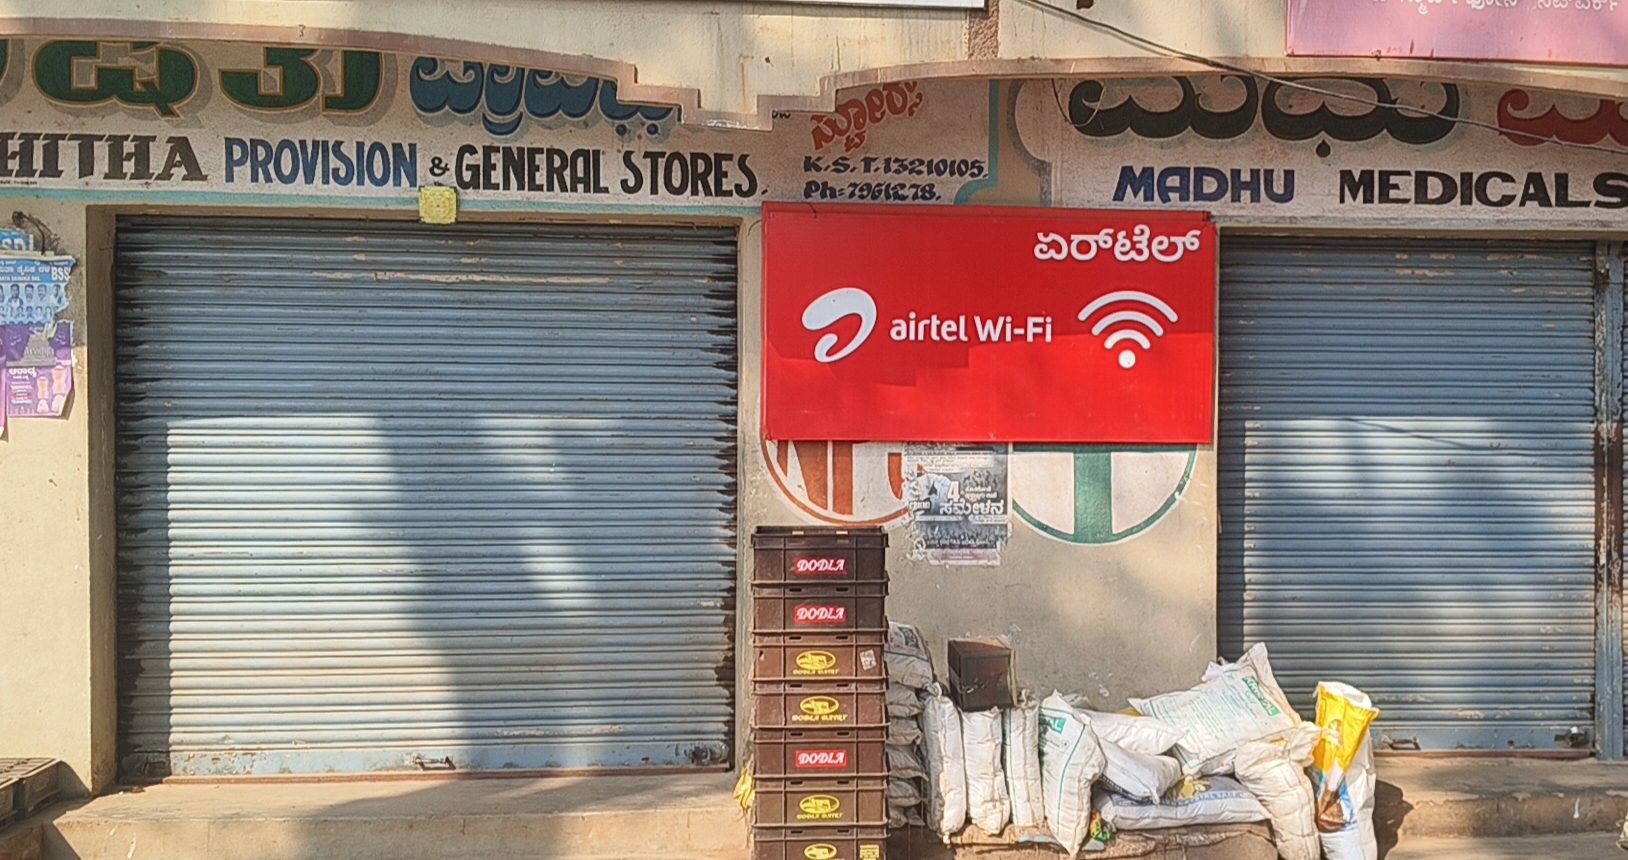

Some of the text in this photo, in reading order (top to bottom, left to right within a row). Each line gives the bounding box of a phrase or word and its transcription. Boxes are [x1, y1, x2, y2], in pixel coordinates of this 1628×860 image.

[225, 137, 417, 189] PROVISION
[429, 156, 450, 178] &
[455, 143, 610, 195] GENERAL
[1113, 165, 1628, 208] MADHU MEDICALS
[889, 311, 1053, 343] airtel Wi-Fi
[796, 558, 845, 572] DODLA
[796, 607, 845, 621] DODLA
[797, 752, 845, 766] DODLA
